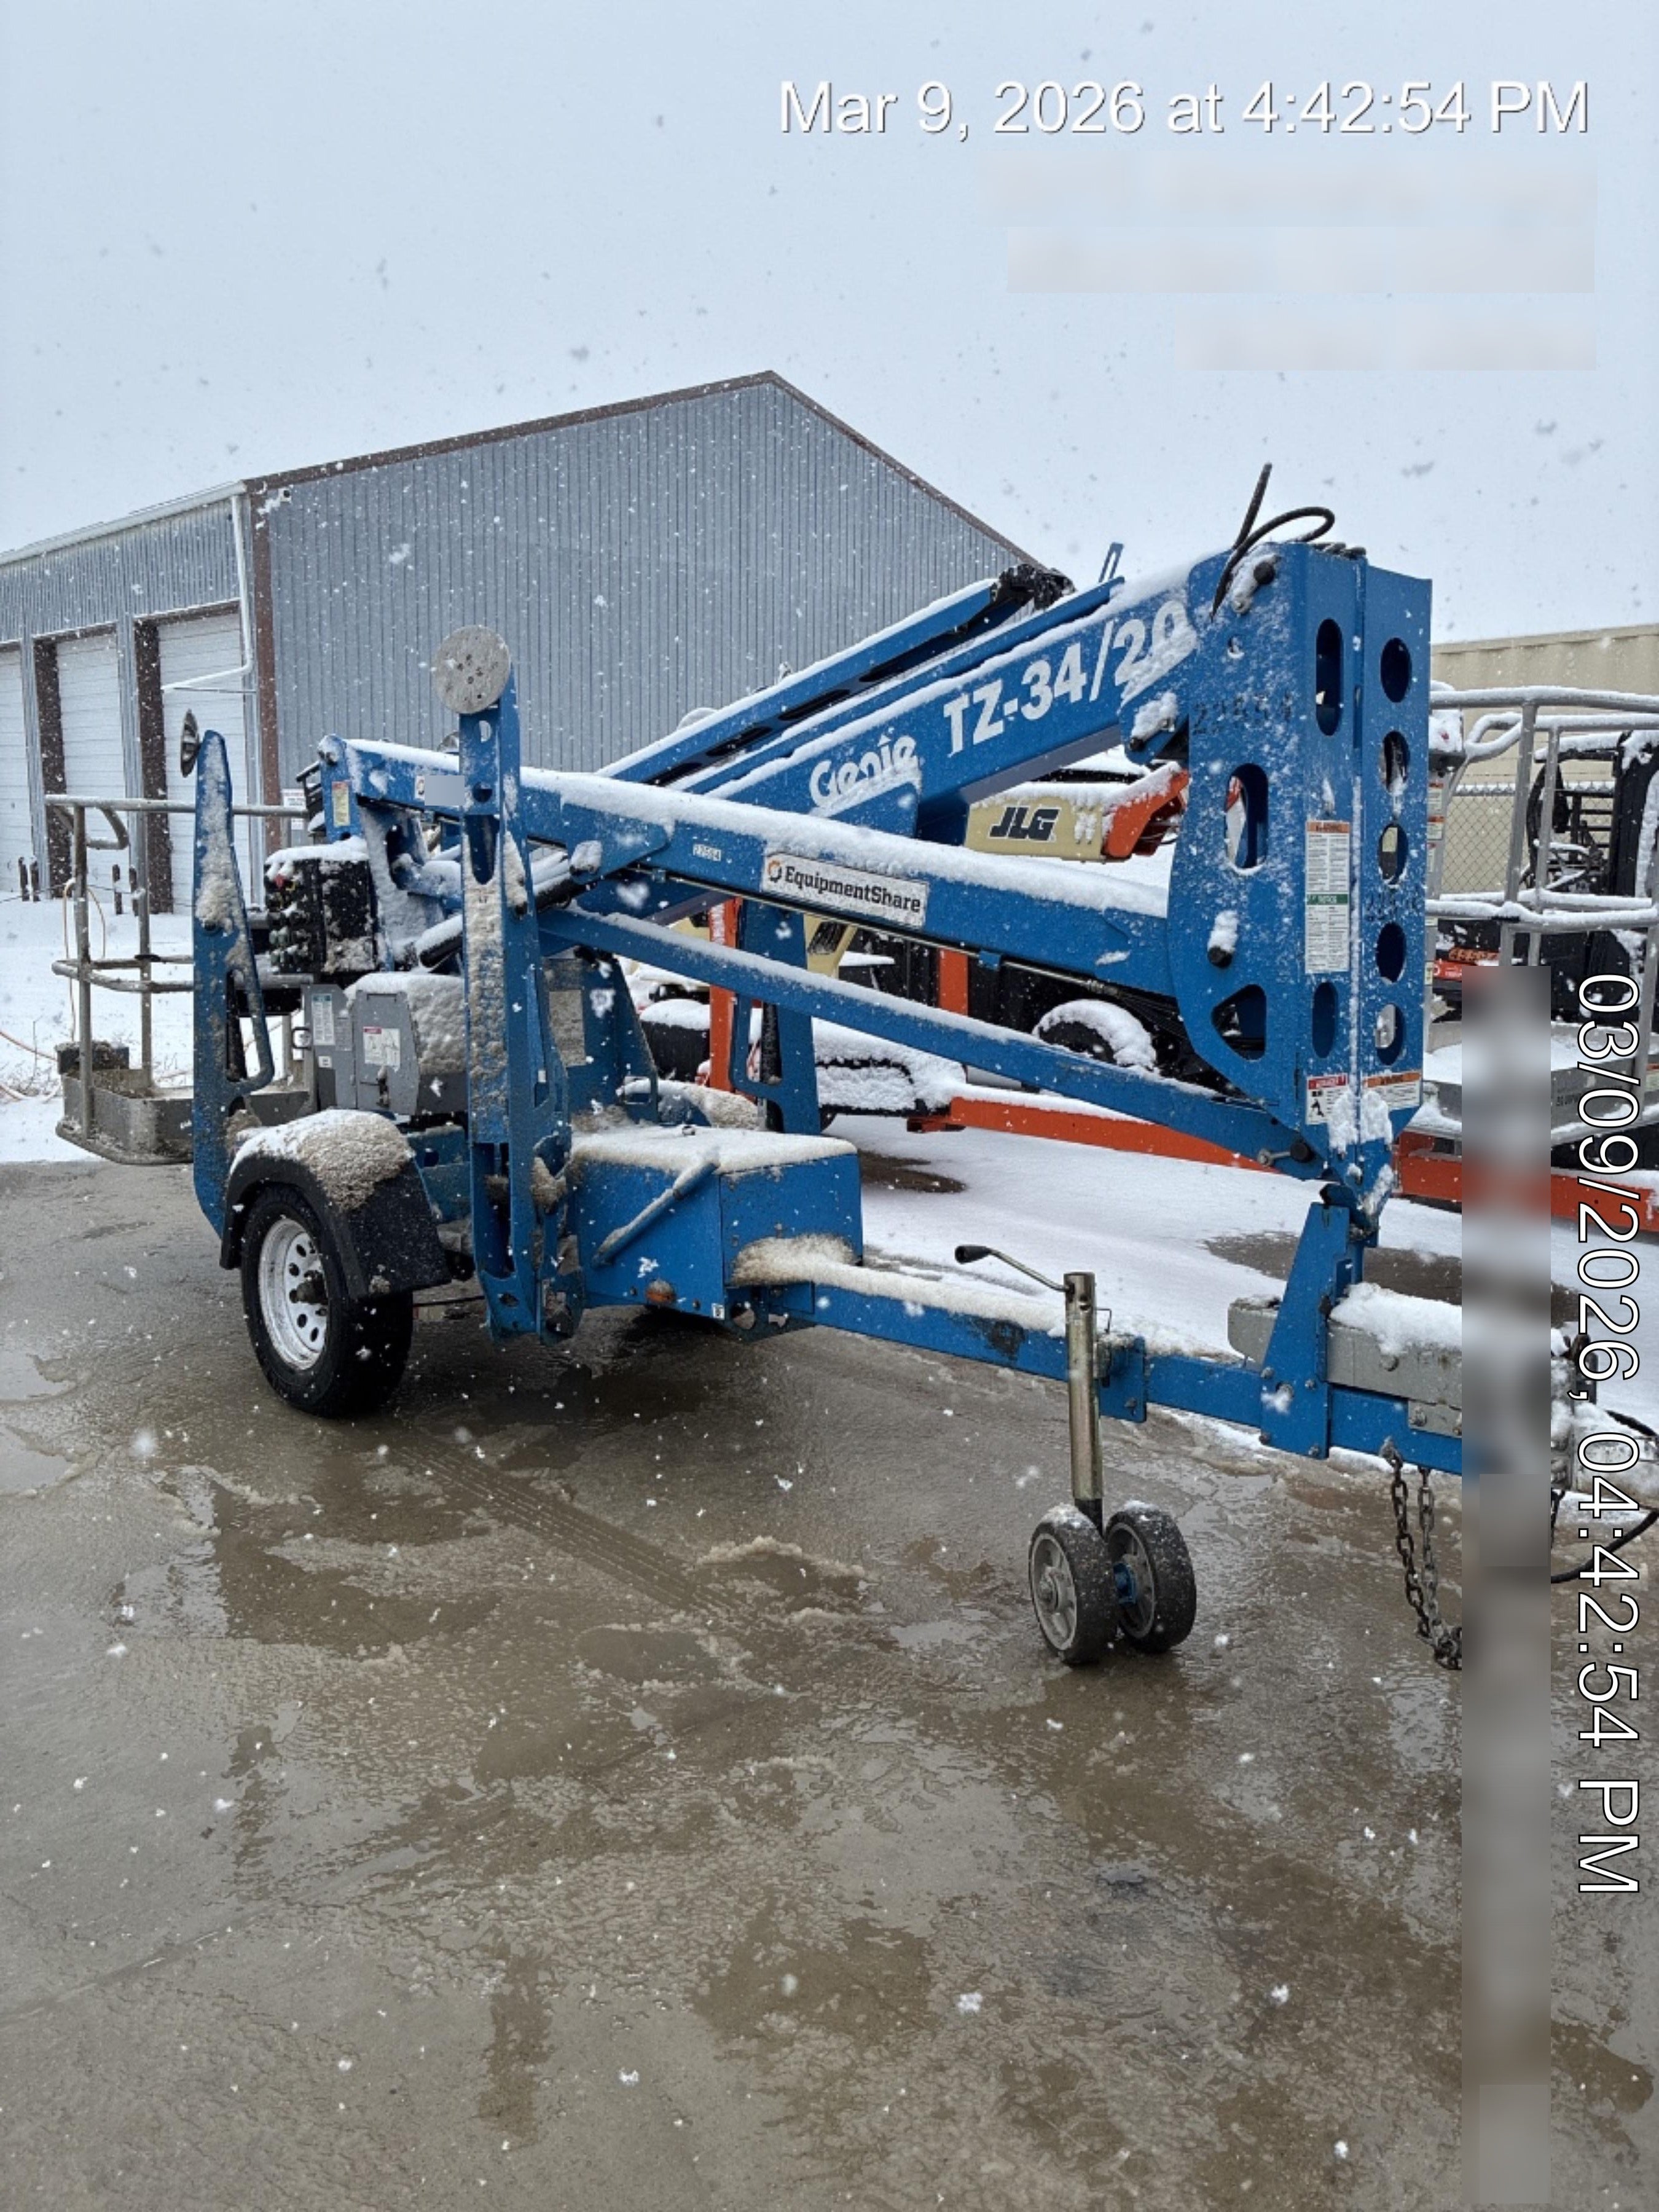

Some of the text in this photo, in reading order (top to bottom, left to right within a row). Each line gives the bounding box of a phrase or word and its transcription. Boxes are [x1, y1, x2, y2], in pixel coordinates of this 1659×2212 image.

[809, 727, 920, 810] Genie
[989, 806, 1059, 842] JLG
[785, 866, 921, 913] EquipmentShare
